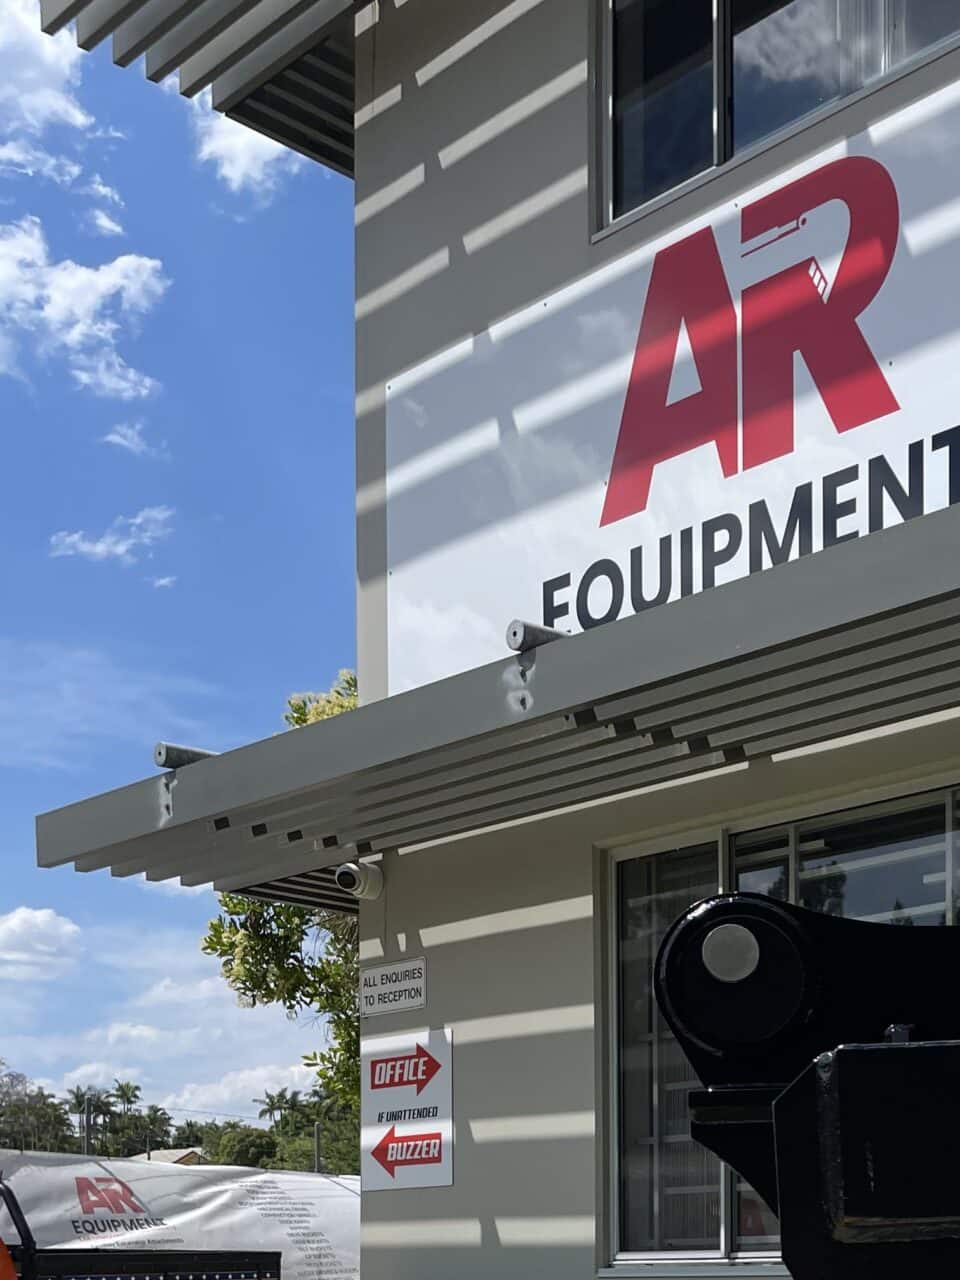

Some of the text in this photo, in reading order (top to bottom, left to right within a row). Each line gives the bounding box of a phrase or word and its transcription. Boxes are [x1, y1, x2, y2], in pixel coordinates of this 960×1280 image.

[600, 156, 901, 528] AR
[363, 967, 423, 988] ALL ENQUIRIES
[364, 986, 422, 1007] TO RECEPTION
[374, 1057, 429, 1085] OFFICE
[378, 1106, 439, 1123] IF UNATTENDED
[387, 1139, 440, 1161] BUZZER
[75, 1177, 146, 1214] AR
[71, 1218, 167, 1235] EQUIPMENT
